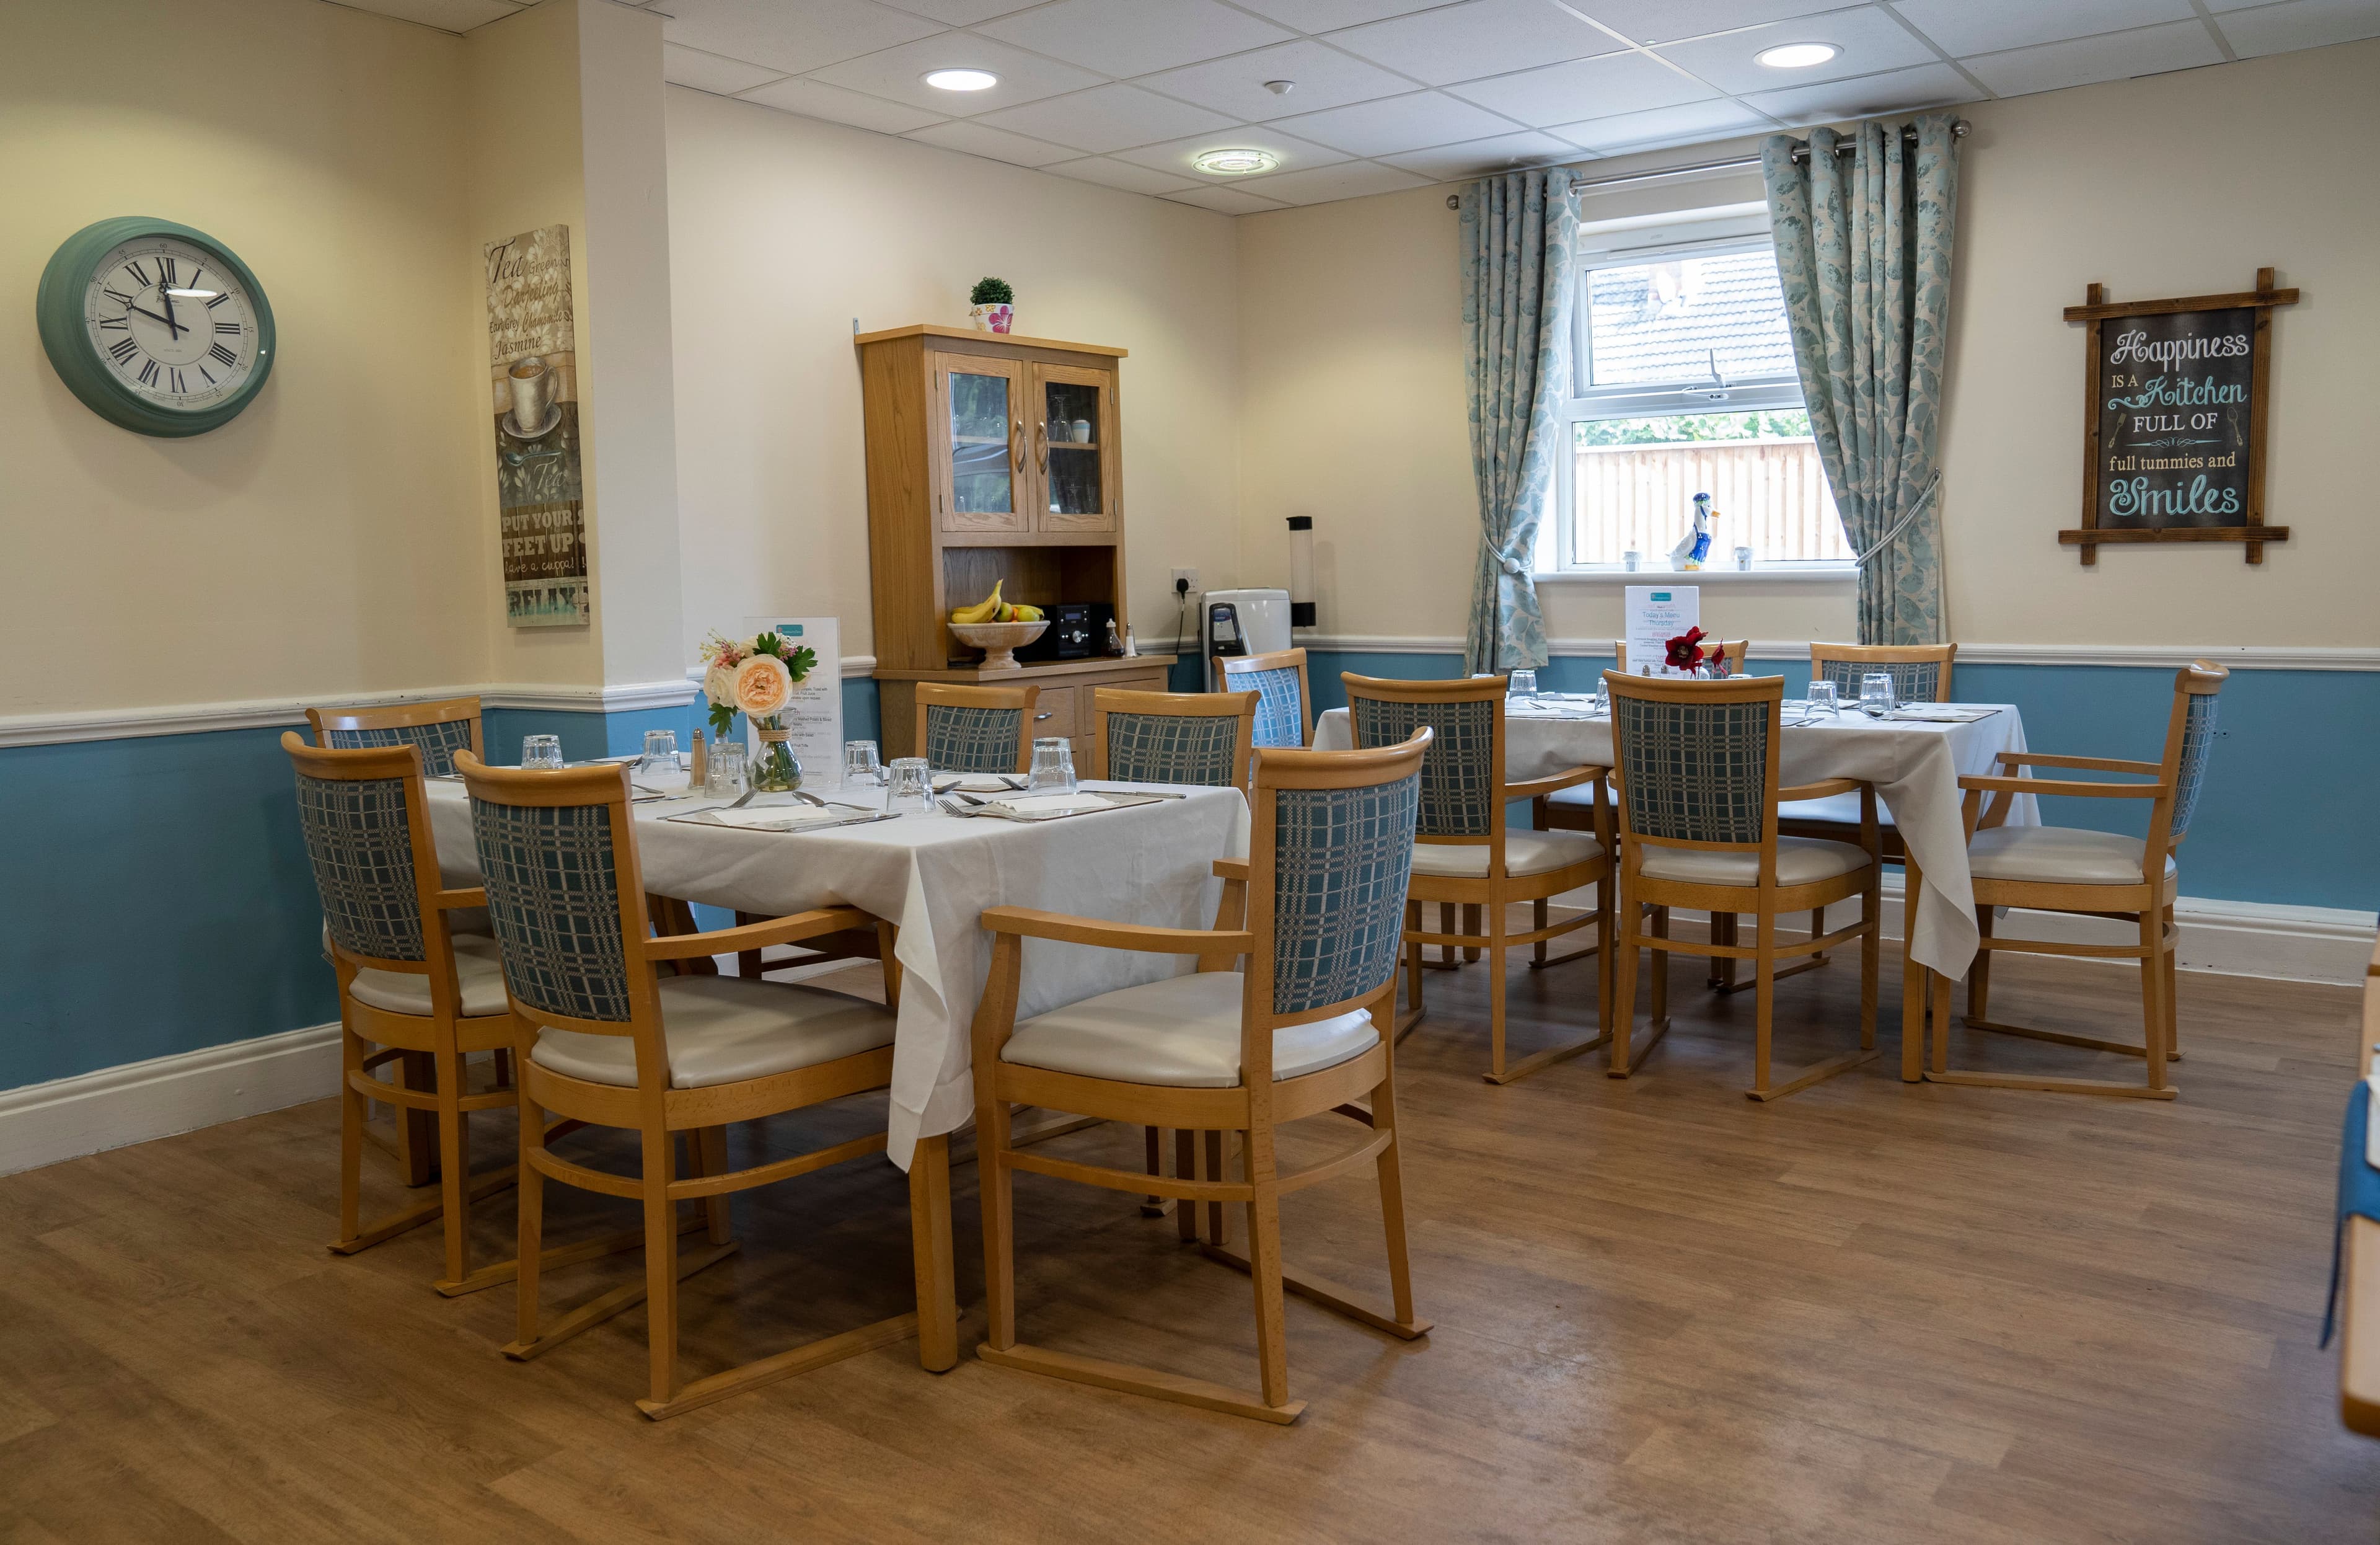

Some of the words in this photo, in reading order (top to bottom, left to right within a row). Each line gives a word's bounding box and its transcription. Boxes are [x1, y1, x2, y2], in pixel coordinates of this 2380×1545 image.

[118, 248, 126, 257] 55
[489, 238, 528, 284] Tea
[529, 257, 560, 275] Green
[90, 276, 98, 284] 50
[123, 261, 152, 290] XI
[234, 287, 240, 295] 10
[502, 282, 560, 309] Darjeeling
[99, 313, 129, 330] IX
[214, 322, 240, 335] III
[490, 319, 505, 334] Earl
[505, 317, 521, 332] Grey
[522, 311, 563, 334] Chamomile
[108, 337, 139, 368] VIII
[495, 335, 542, 360] Jasmine
[2110, 329, 2249, 372] Happiness
[136, 358, 161, 388] VII
[169, 366, 188, 393] VI
[199, 364, 217, 387] V
[2112, 374, 2124, 388] IS
[2128, 374, 2139, 387] A
[2108, 375, 2247, 410] Kitchen
[2133, 414, 2185, 433] FULL
[2190, 412, 2218, 430] OF
[2109, 455, 2135, 471] full
[2141, 453, 2203, 469] tummies
[2208, 451, 2236, 467] and
[533, 457, 566, 490] Tea
[2109, 474, 2239, 516] Smiles
[502, 515, 529, 533] PUT
[532, 510, 573, 531] YOUR
[503, 536, 547, 558] FEET
[550, 533, 573, 554] UP
[505, 560, 528, 574] have
[531, 562, 539, 571] a
[542, 557, 575, 576] cuppa!
[508, 587, 577, 617] RELAX
